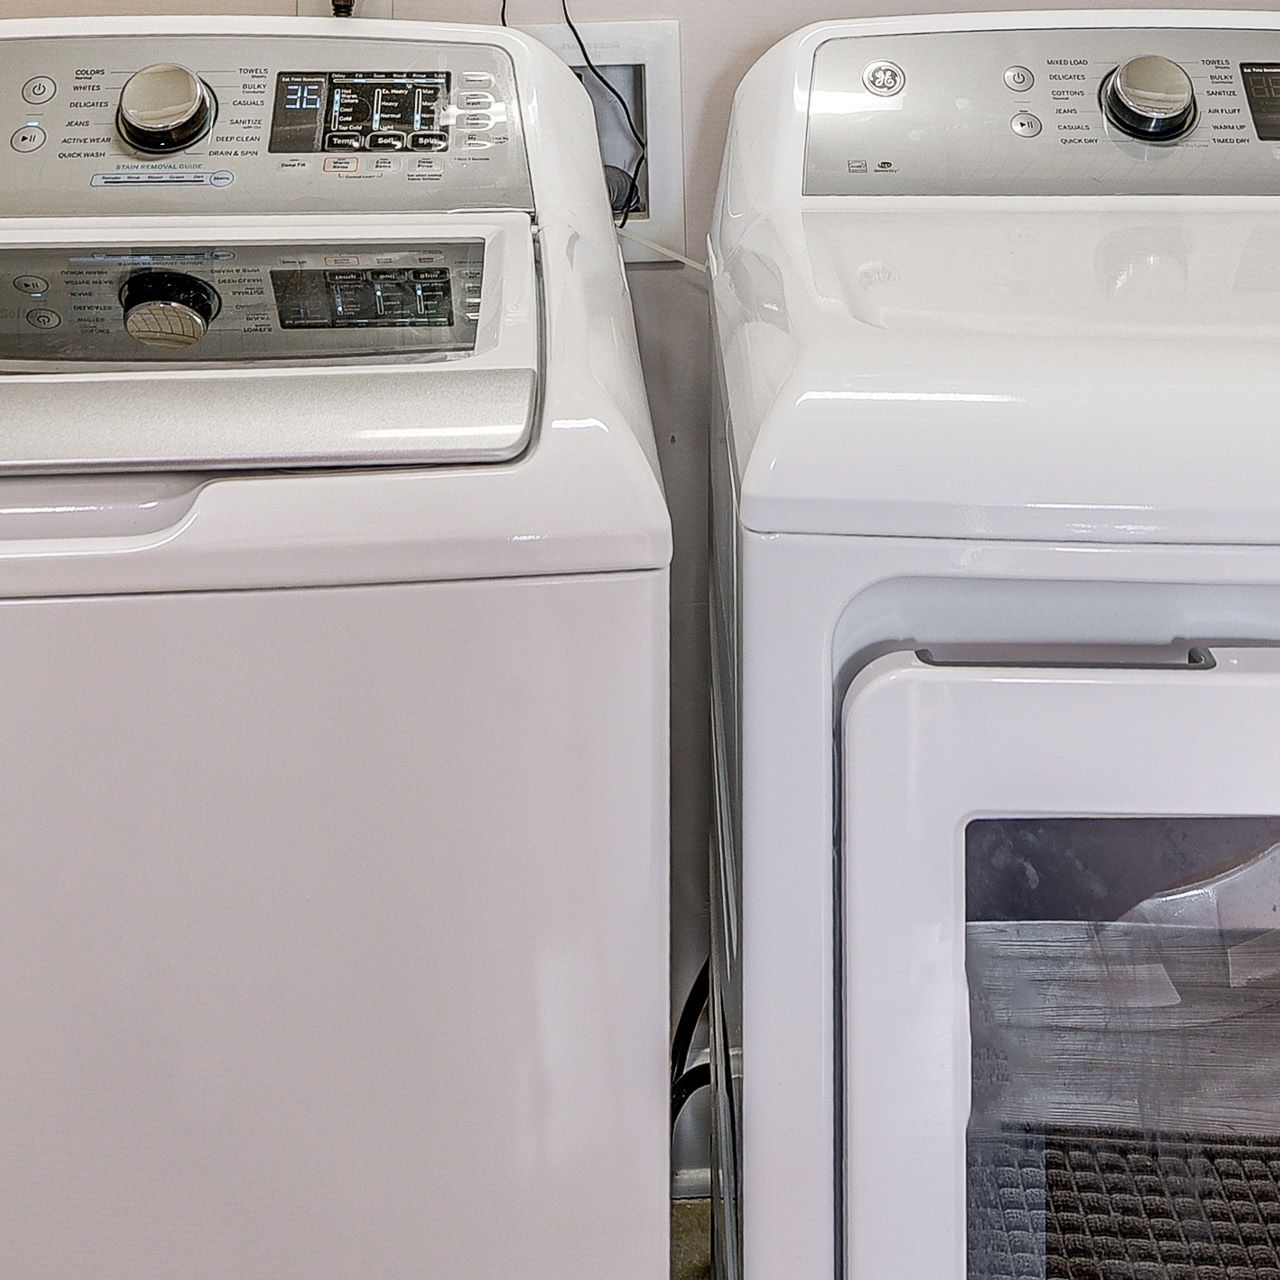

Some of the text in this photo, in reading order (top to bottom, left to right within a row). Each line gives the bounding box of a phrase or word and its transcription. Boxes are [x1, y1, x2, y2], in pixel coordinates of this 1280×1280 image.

[74, 68, 106, 76] COLORS
[239, 67, 269, 75] TOWELS
[285, 84, 321, 109] 36
[1051, 89, 1085, 97] COTTONS
[1206, 89, 1238, 97] SANITIZE
[69, 101, 110, 109] DELICATES
[232, 99, 265, 107] CASUALS
[65, 120, 91, 128] JEANS
